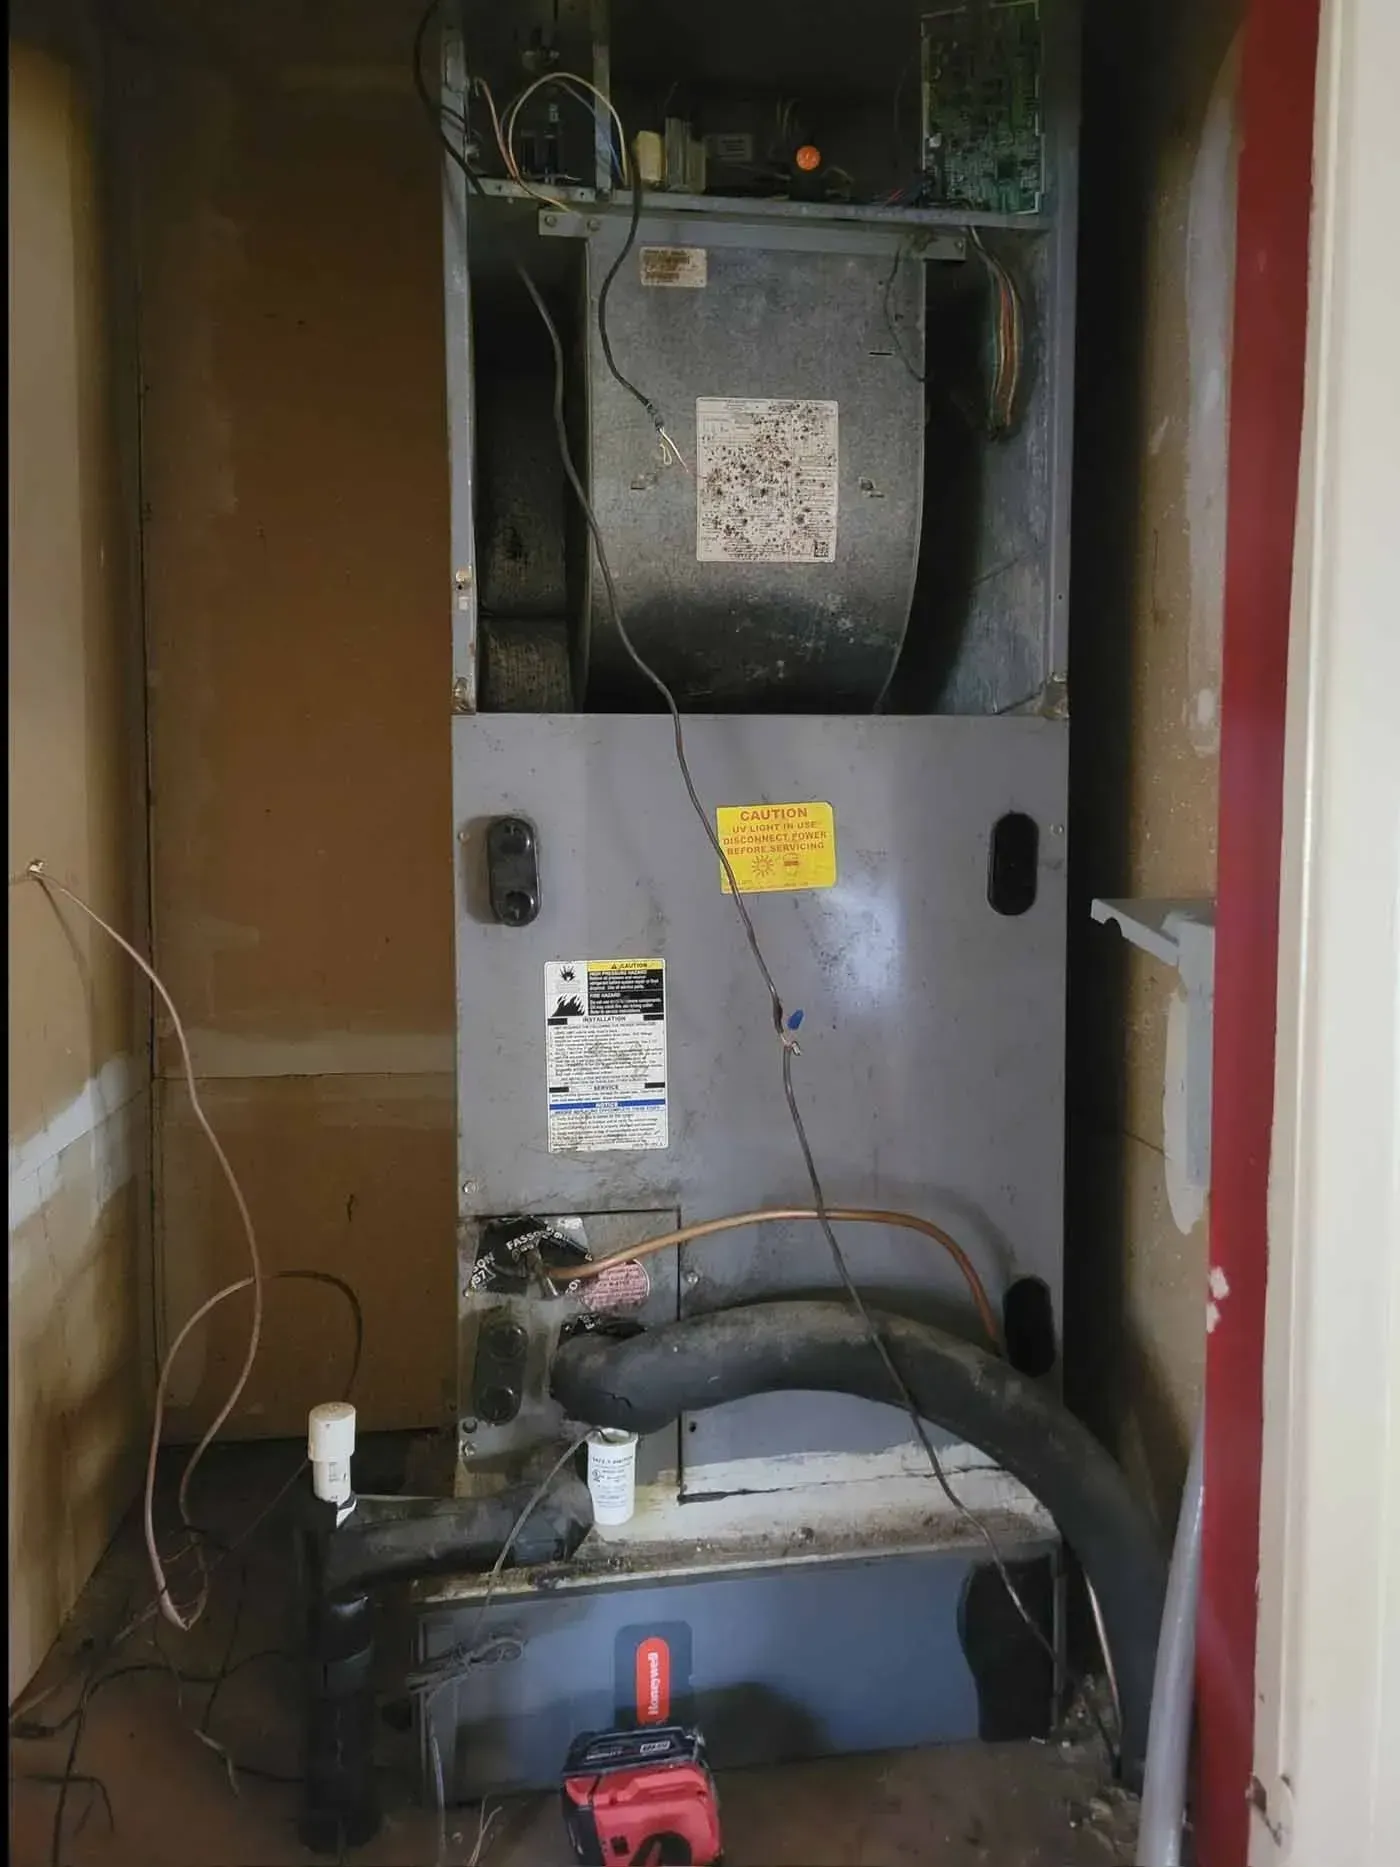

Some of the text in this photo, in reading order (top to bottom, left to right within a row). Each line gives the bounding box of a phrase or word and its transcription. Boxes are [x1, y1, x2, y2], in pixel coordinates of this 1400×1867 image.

[740, 807, 808, 821] CAUTION
[732, 820, 817, 834] UV LIGHT IN USE
[723, 831, 827, 846] DISCONNECT POWER
[727, 841, 824, 856] BEFORE SERVICING
[647, 1651, 660, 1715] Honeywell
